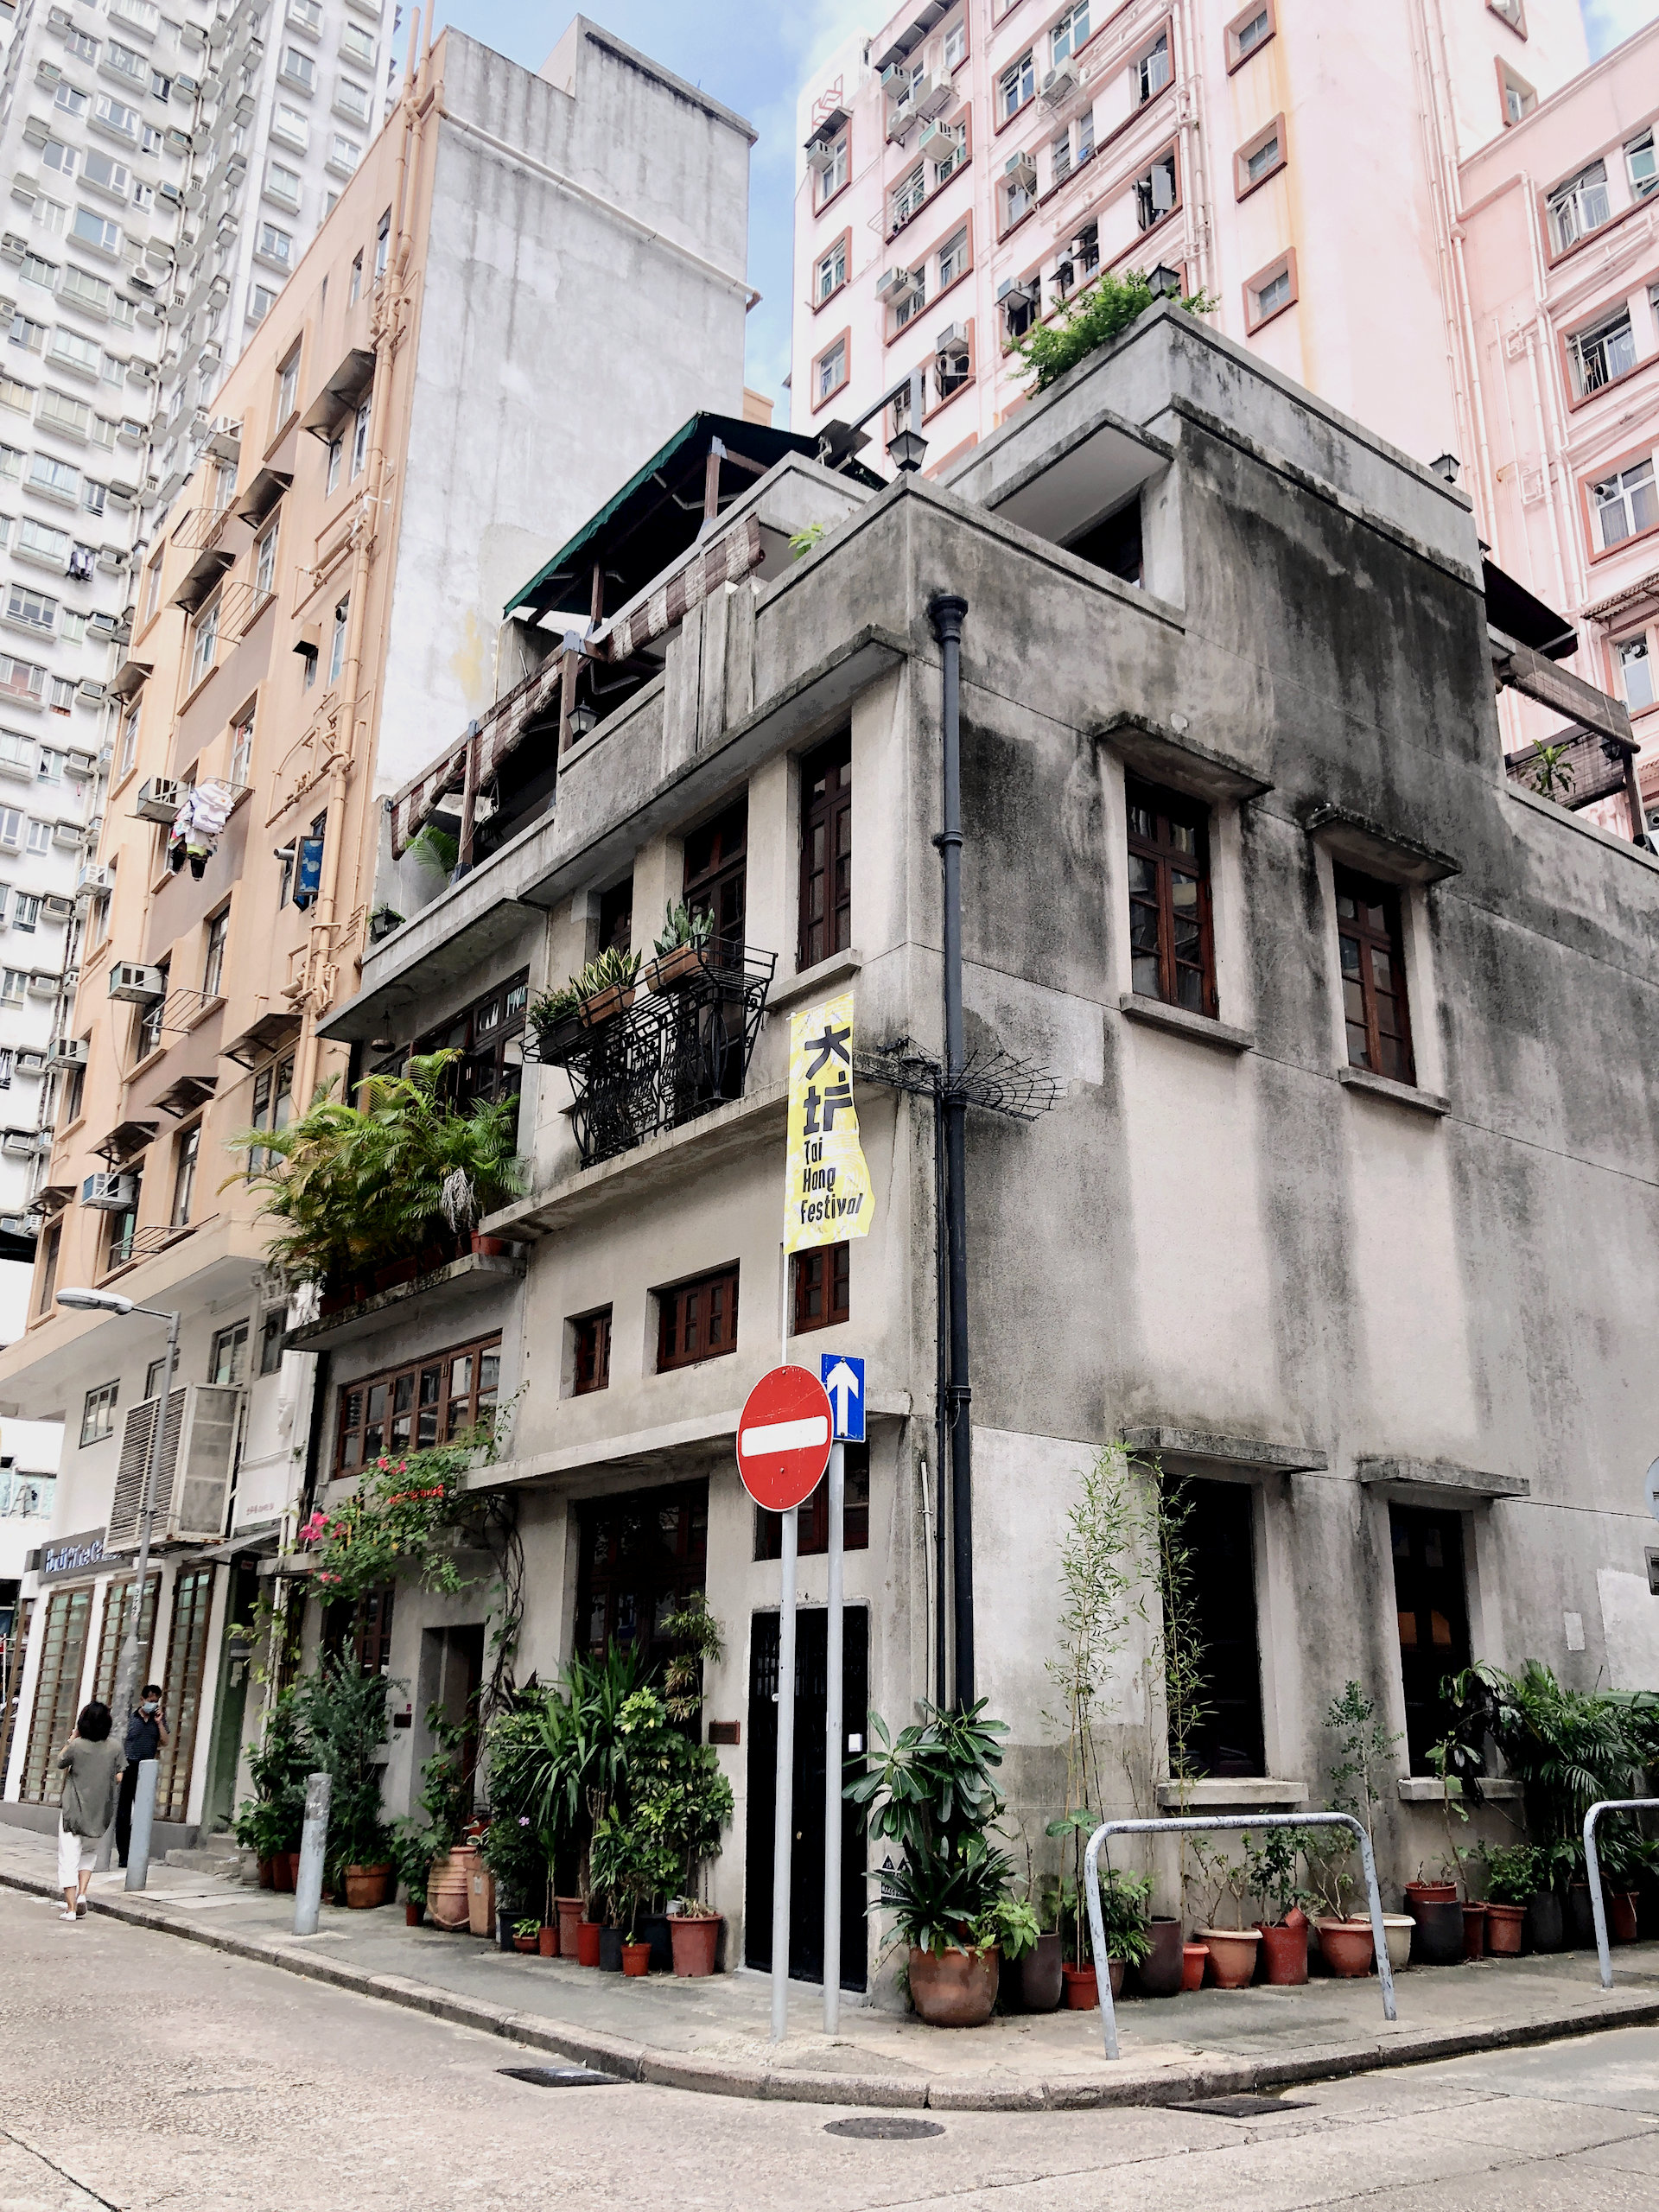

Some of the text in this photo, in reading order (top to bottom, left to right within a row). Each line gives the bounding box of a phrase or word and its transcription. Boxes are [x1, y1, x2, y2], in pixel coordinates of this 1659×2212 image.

[804, 1025, 853, 1136] 大坑
[804, 1137, 823, 1165] Tai
[803, 1166, 836, 1192] Hang
[801, 1192, 863, 1224] Festival
